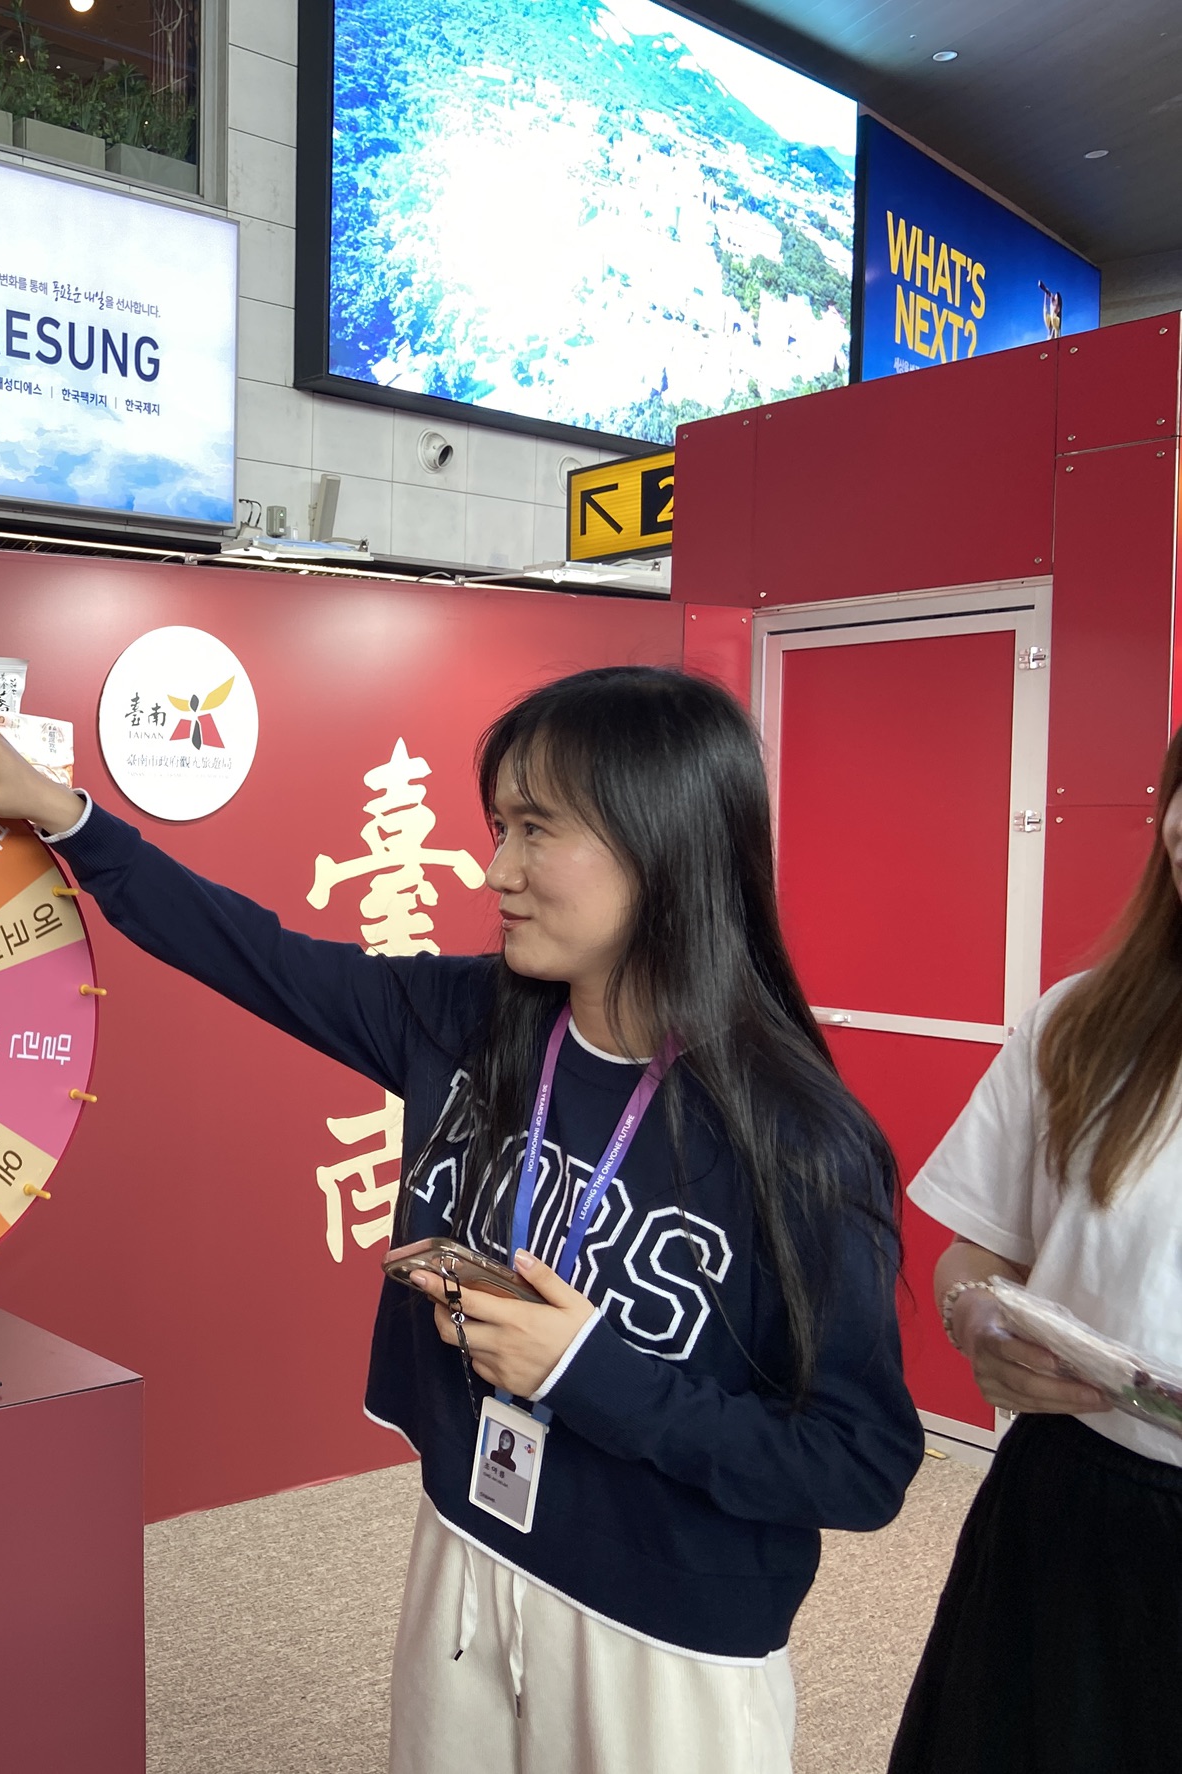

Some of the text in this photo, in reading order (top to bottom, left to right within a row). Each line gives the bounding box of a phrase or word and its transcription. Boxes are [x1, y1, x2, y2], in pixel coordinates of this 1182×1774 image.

[886, 210, 986, 320] WHAT'S
[0, 272, 28, 291] 변화를
[29, 279, 48, 295] 통해
[52, 280, 82, 304] 풍요로운
[84, 290, 114, 311] 내일을
[116, 298, 162, 318] 선사합니다.
[894, 284, 978, 367] NEXT?
[62, 387, 107, 408] 한국팩키지
[125, 398, 160, 416] 한국제지
[657, 475, 675, 523] 2
[124, 692, 166, 727] 臺南
[10, 1031, 72, 1066] 말린
[535, 1116, 543, 1127] OF
[537, 1093, 546, 1116] YEARS
[527, 1127, 540, 1173] INNOVATION
[578, 1114, 636, 1221] LEADING THE ONLYONE FUTURE
